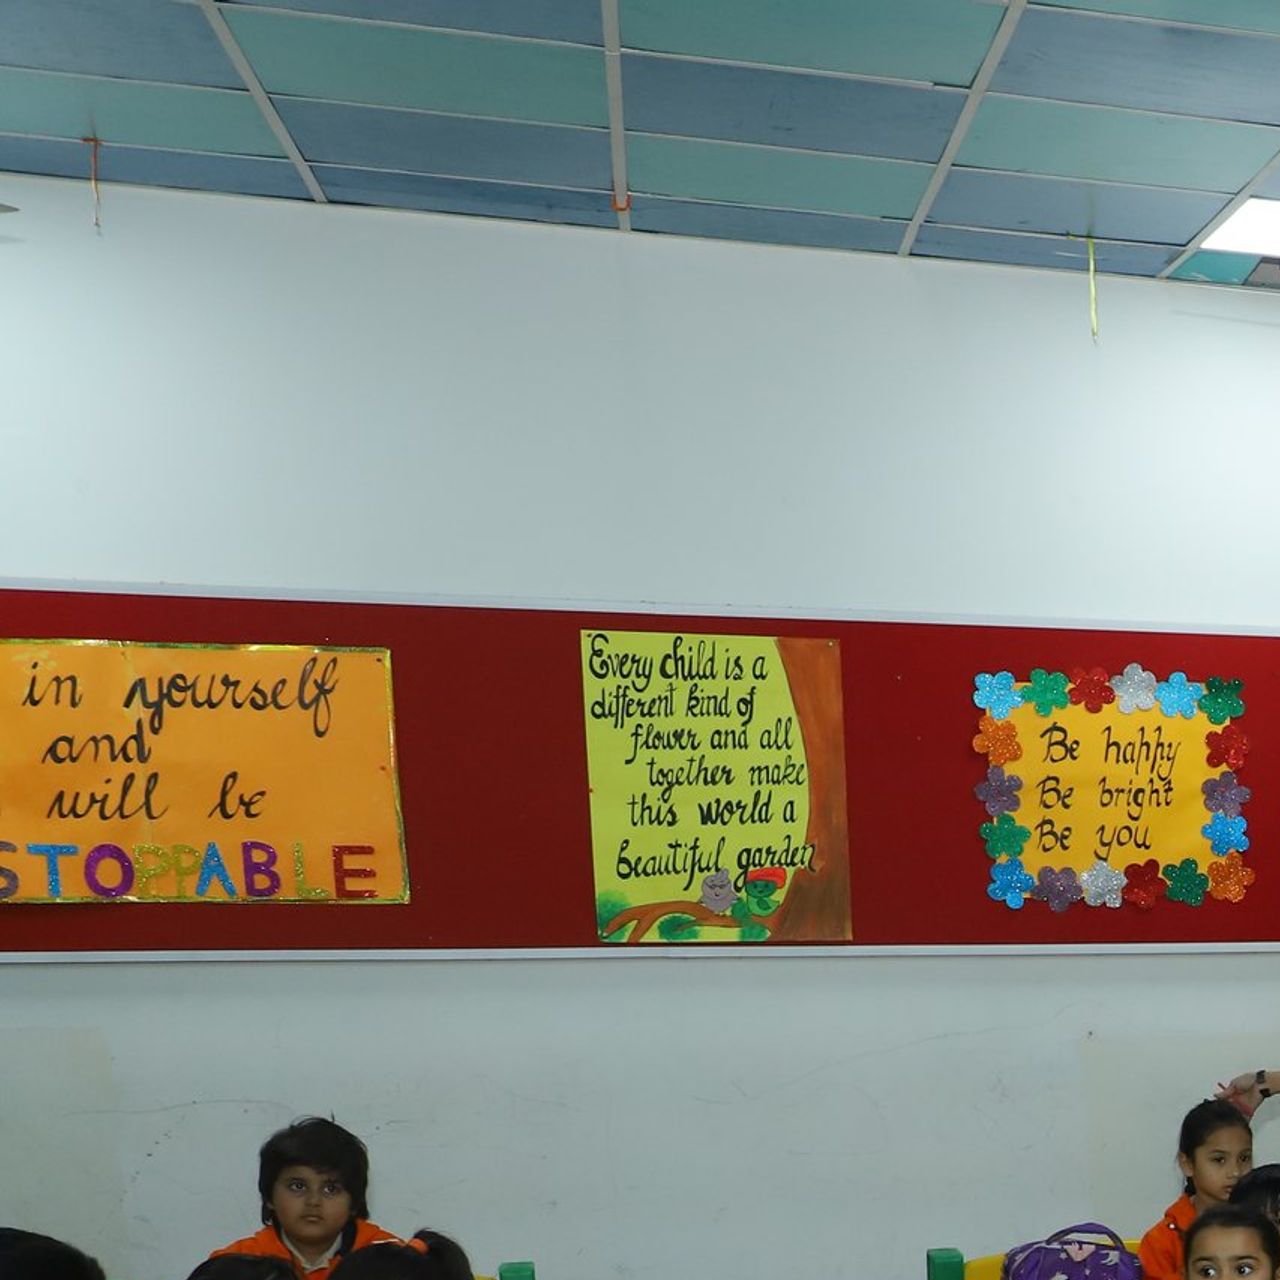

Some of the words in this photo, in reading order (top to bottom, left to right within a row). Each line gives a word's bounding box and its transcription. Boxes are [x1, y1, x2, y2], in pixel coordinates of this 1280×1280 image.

[589, 633, 653, 692] Every
[659, 636, 718, 681] child
[725, 648, 743, 680] is
[752, 655, 768, 680] a
[22, 661, 83, 708] in
[122, 656, 339, 738] yourself
[591, 683, 676, 728] different
[685, 683, 732, 718] kind
[736, 685, 757, 726] of
[42, 717, 152, 764] and
[710, 723, 749, 750] and
[759, 716, 796, 750] all
[1040, 722, 1081, 763] Be
[1101, 725, 1182, 782] happy
[47, 772, 169, 820] will
[208, 771, 267, 819] be
[647, 755, 736, 803] together
[748, 755, 805, 786] make
[1035, 775, 1074, 809] Be
[1099, 777, 1174, 822] bright
[627, 793, 680, 827] this
[698, 790, 774, 827] world
[783, 799, 798, 823] a
[1034, 818, 1073, 853] Be
[1094, 824, 1152, 862] you
[733, 835, 817, 893] garden
